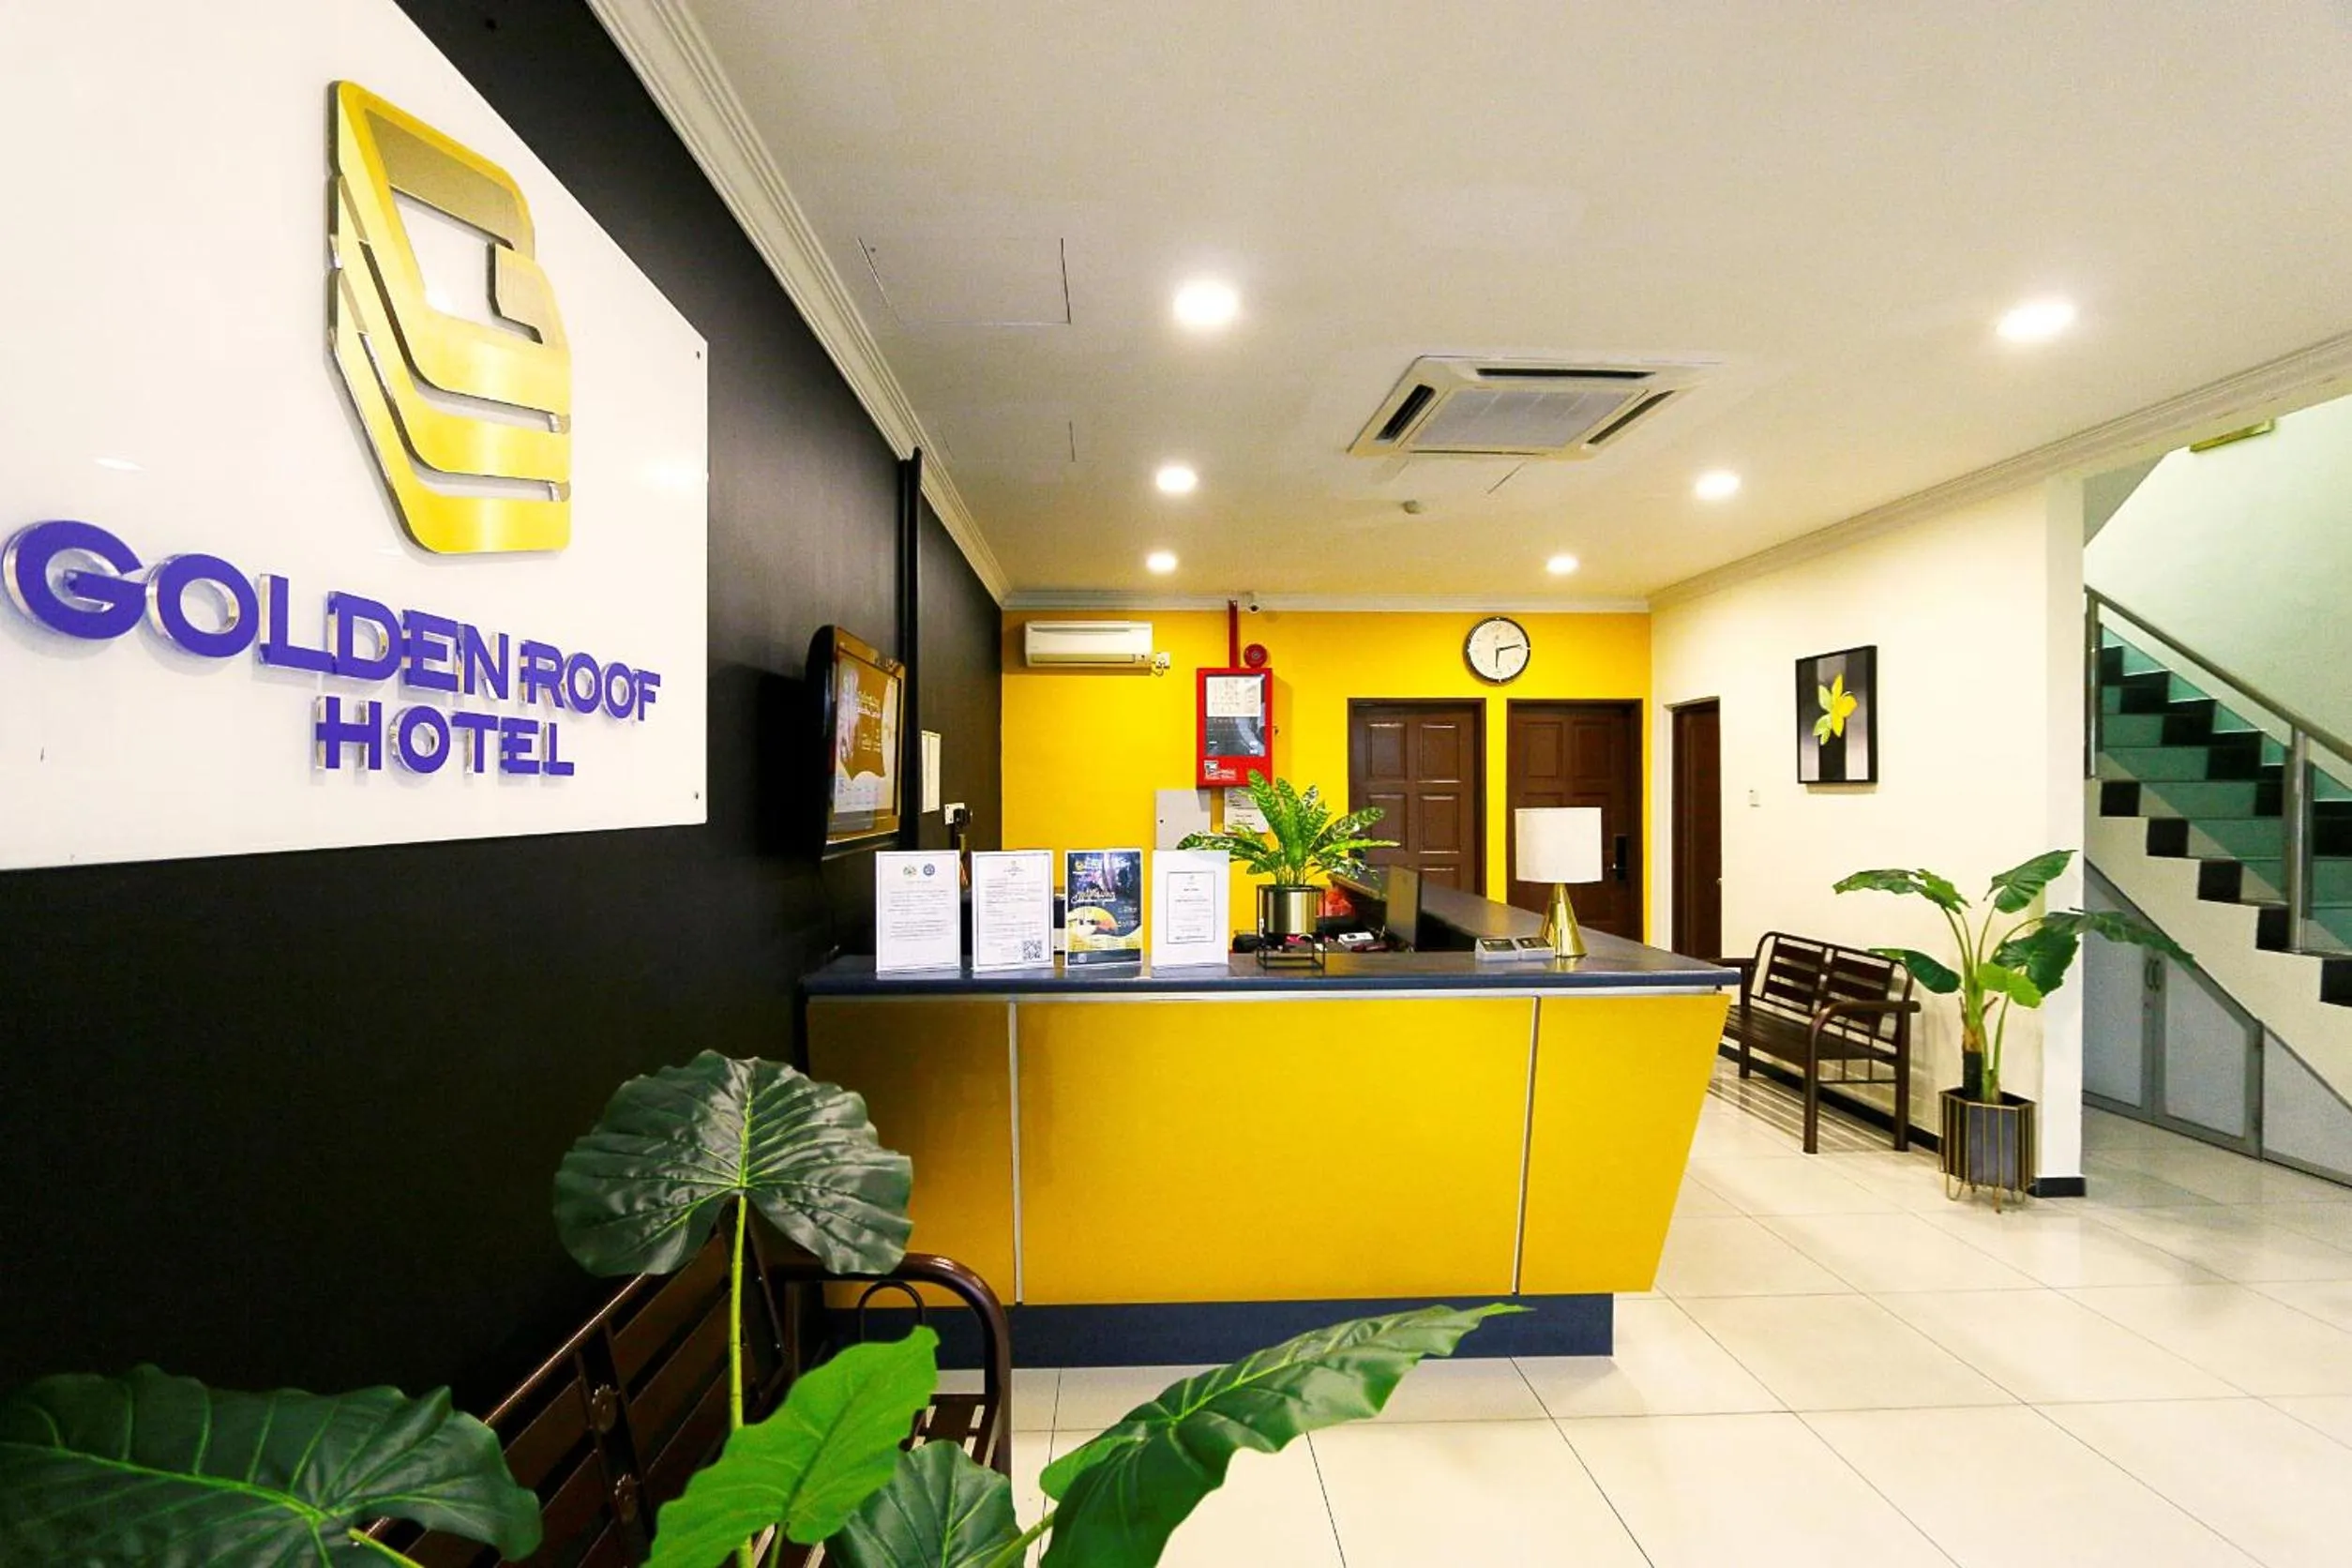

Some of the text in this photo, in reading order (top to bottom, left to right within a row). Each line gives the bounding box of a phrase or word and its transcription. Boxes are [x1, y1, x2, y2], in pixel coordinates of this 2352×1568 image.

[3, 520, 661, 721] GOLDEN ROOF
[315, 695, 575, 776] HOTEL
